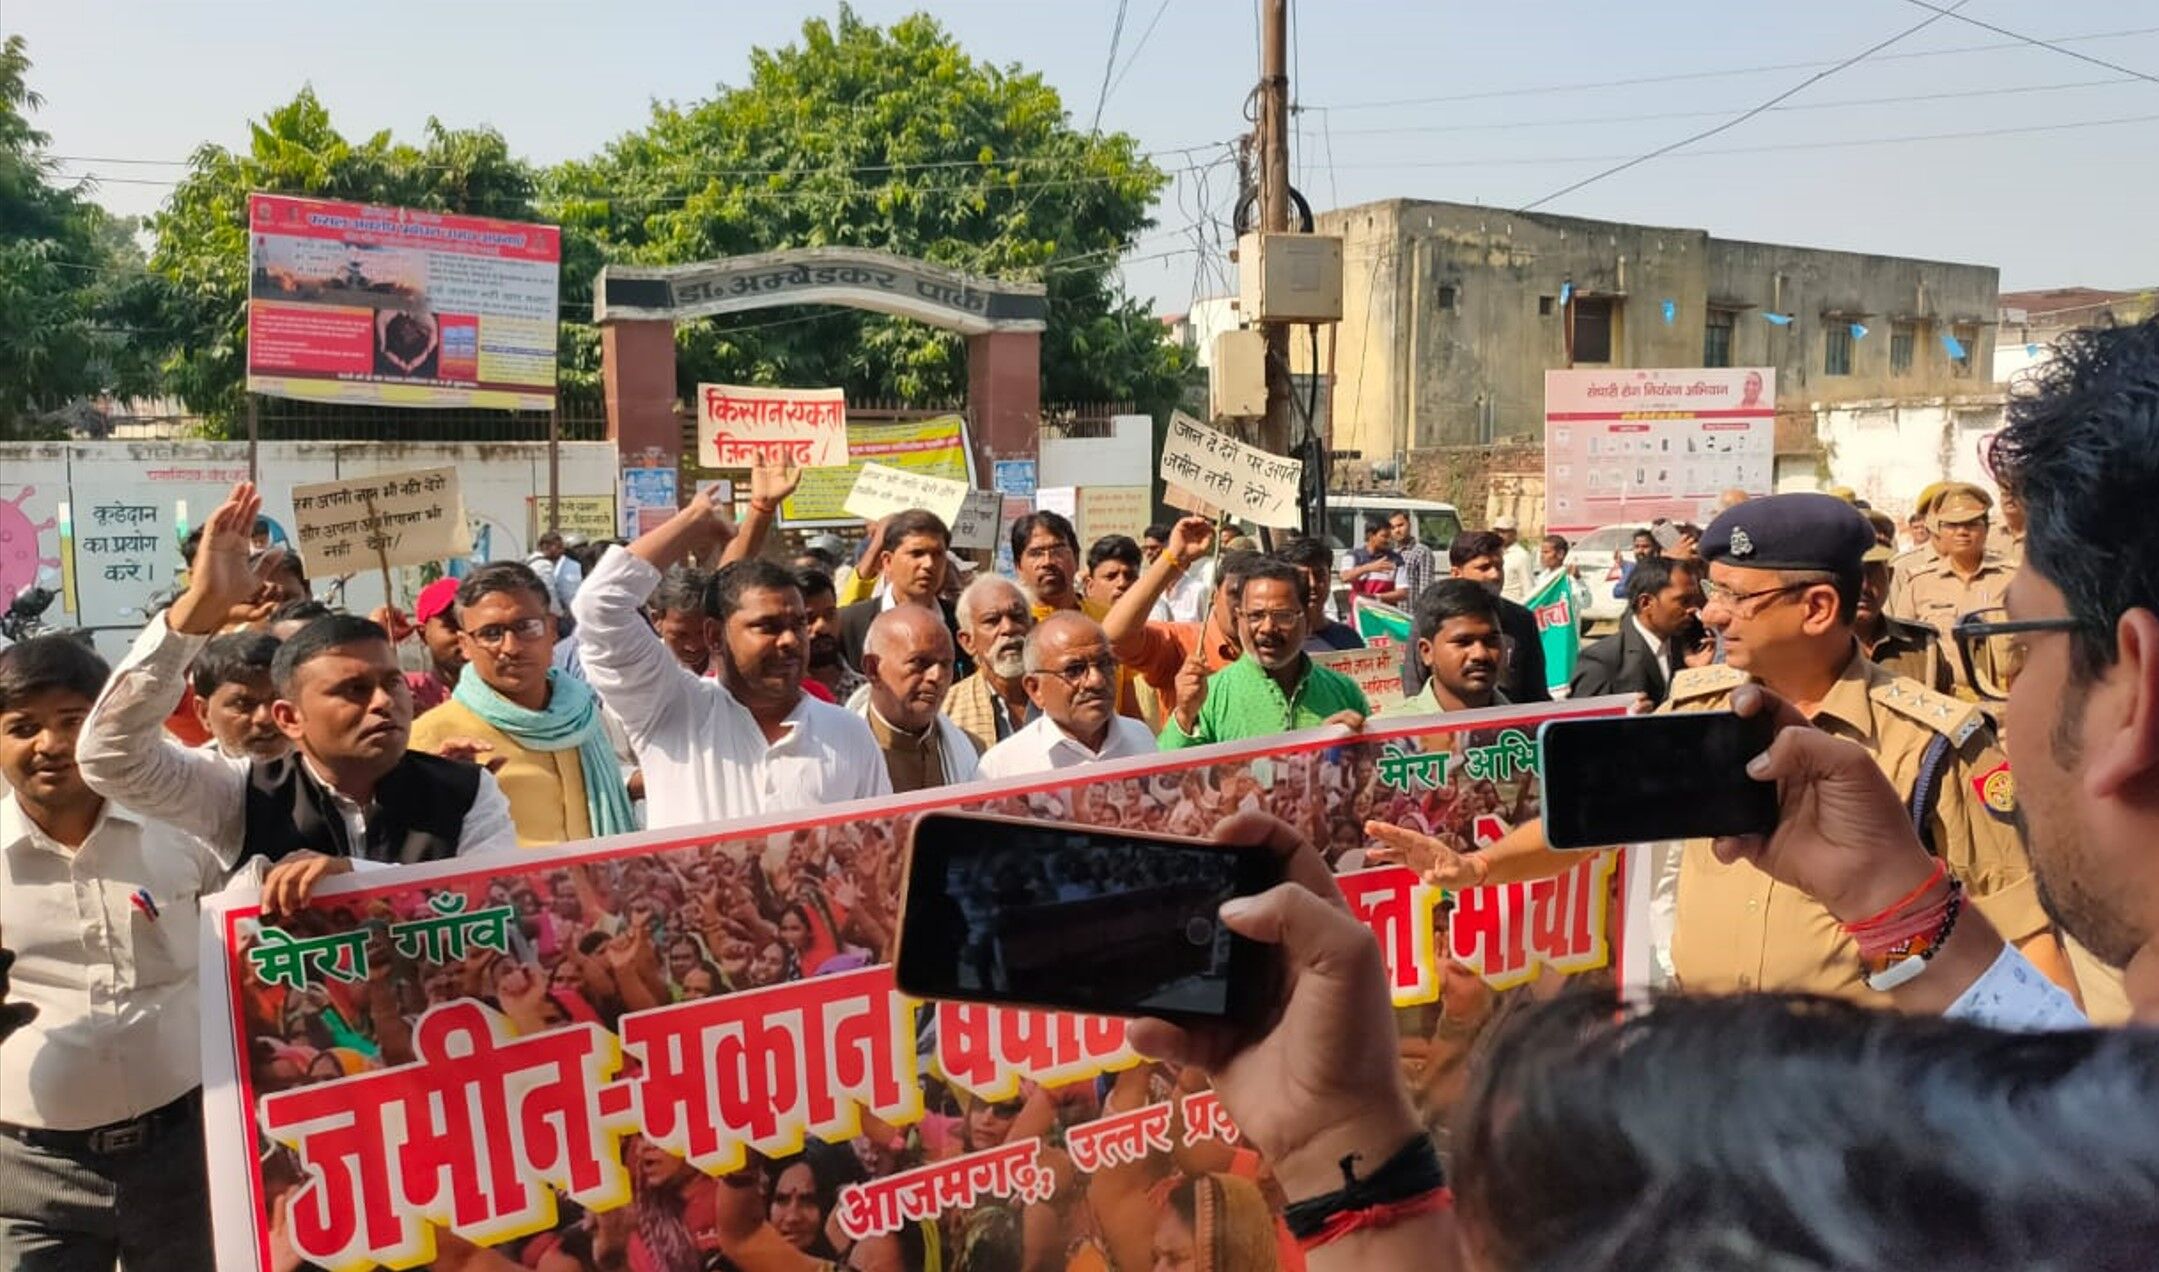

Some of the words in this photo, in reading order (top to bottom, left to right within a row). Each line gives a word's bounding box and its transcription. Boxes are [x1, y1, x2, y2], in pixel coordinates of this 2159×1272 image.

[83, 537, 108, 553] का
[111, 529, 160, 553] प्रयोग
[1377, 745, 1451, 792] मेरा
[250, 927, 371, 991] मेरा
[390, 892, 512, 964] गाँव
[1067, 1100, 1174, 1172] उत्तर
